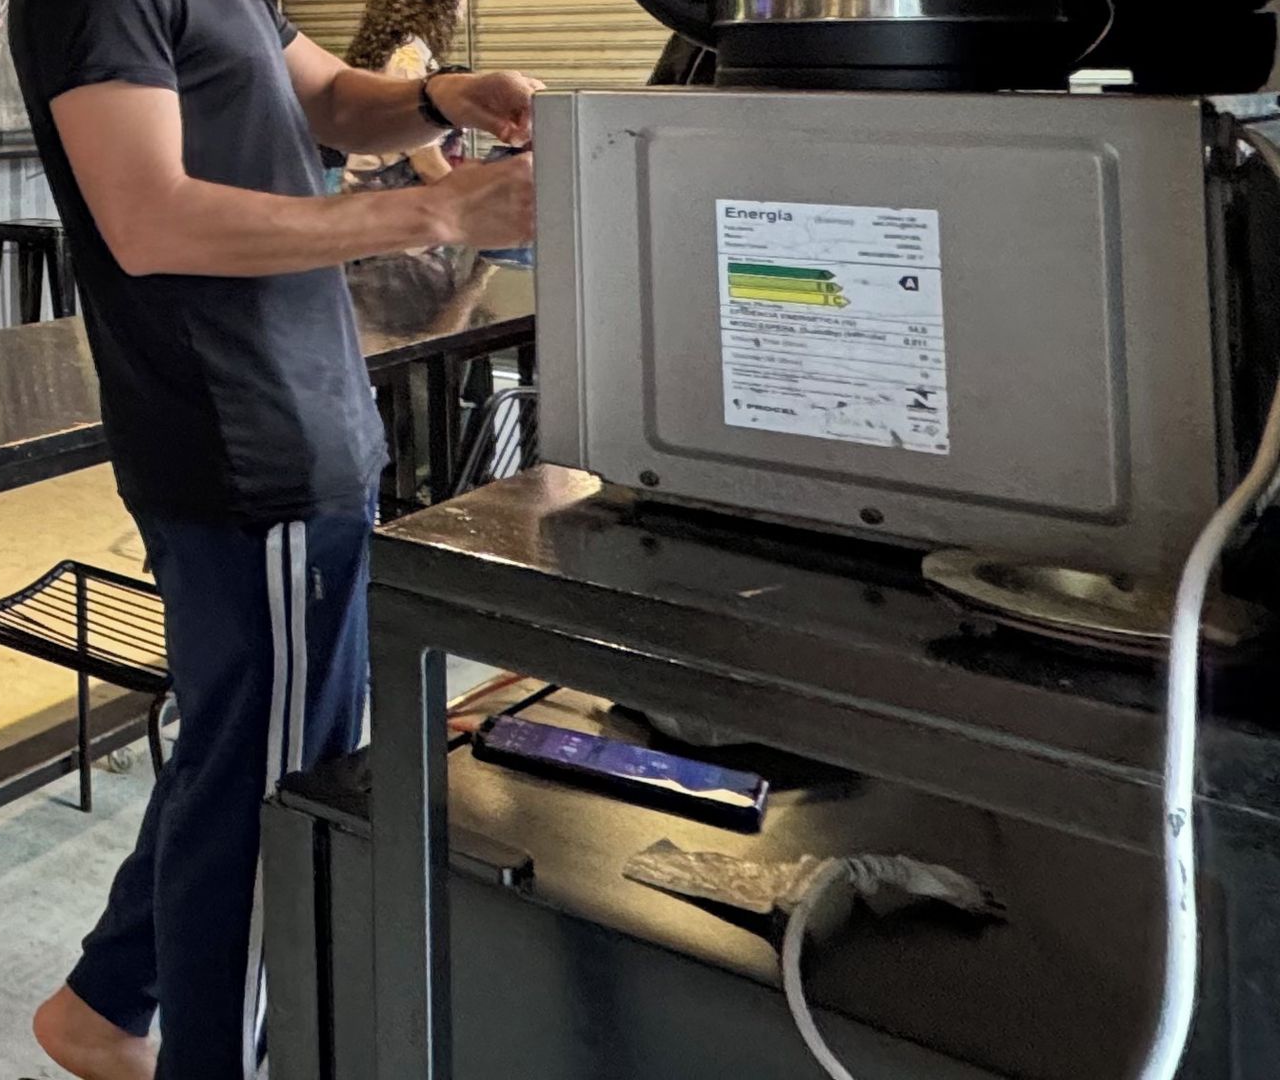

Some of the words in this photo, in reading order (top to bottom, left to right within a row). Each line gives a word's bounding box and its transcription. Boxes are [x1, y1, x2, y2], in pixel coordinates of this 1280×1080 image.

[725, 207, 793, 223] Energia
[905, 279, 915, 289] A
[833, 296, 844, 306] C
